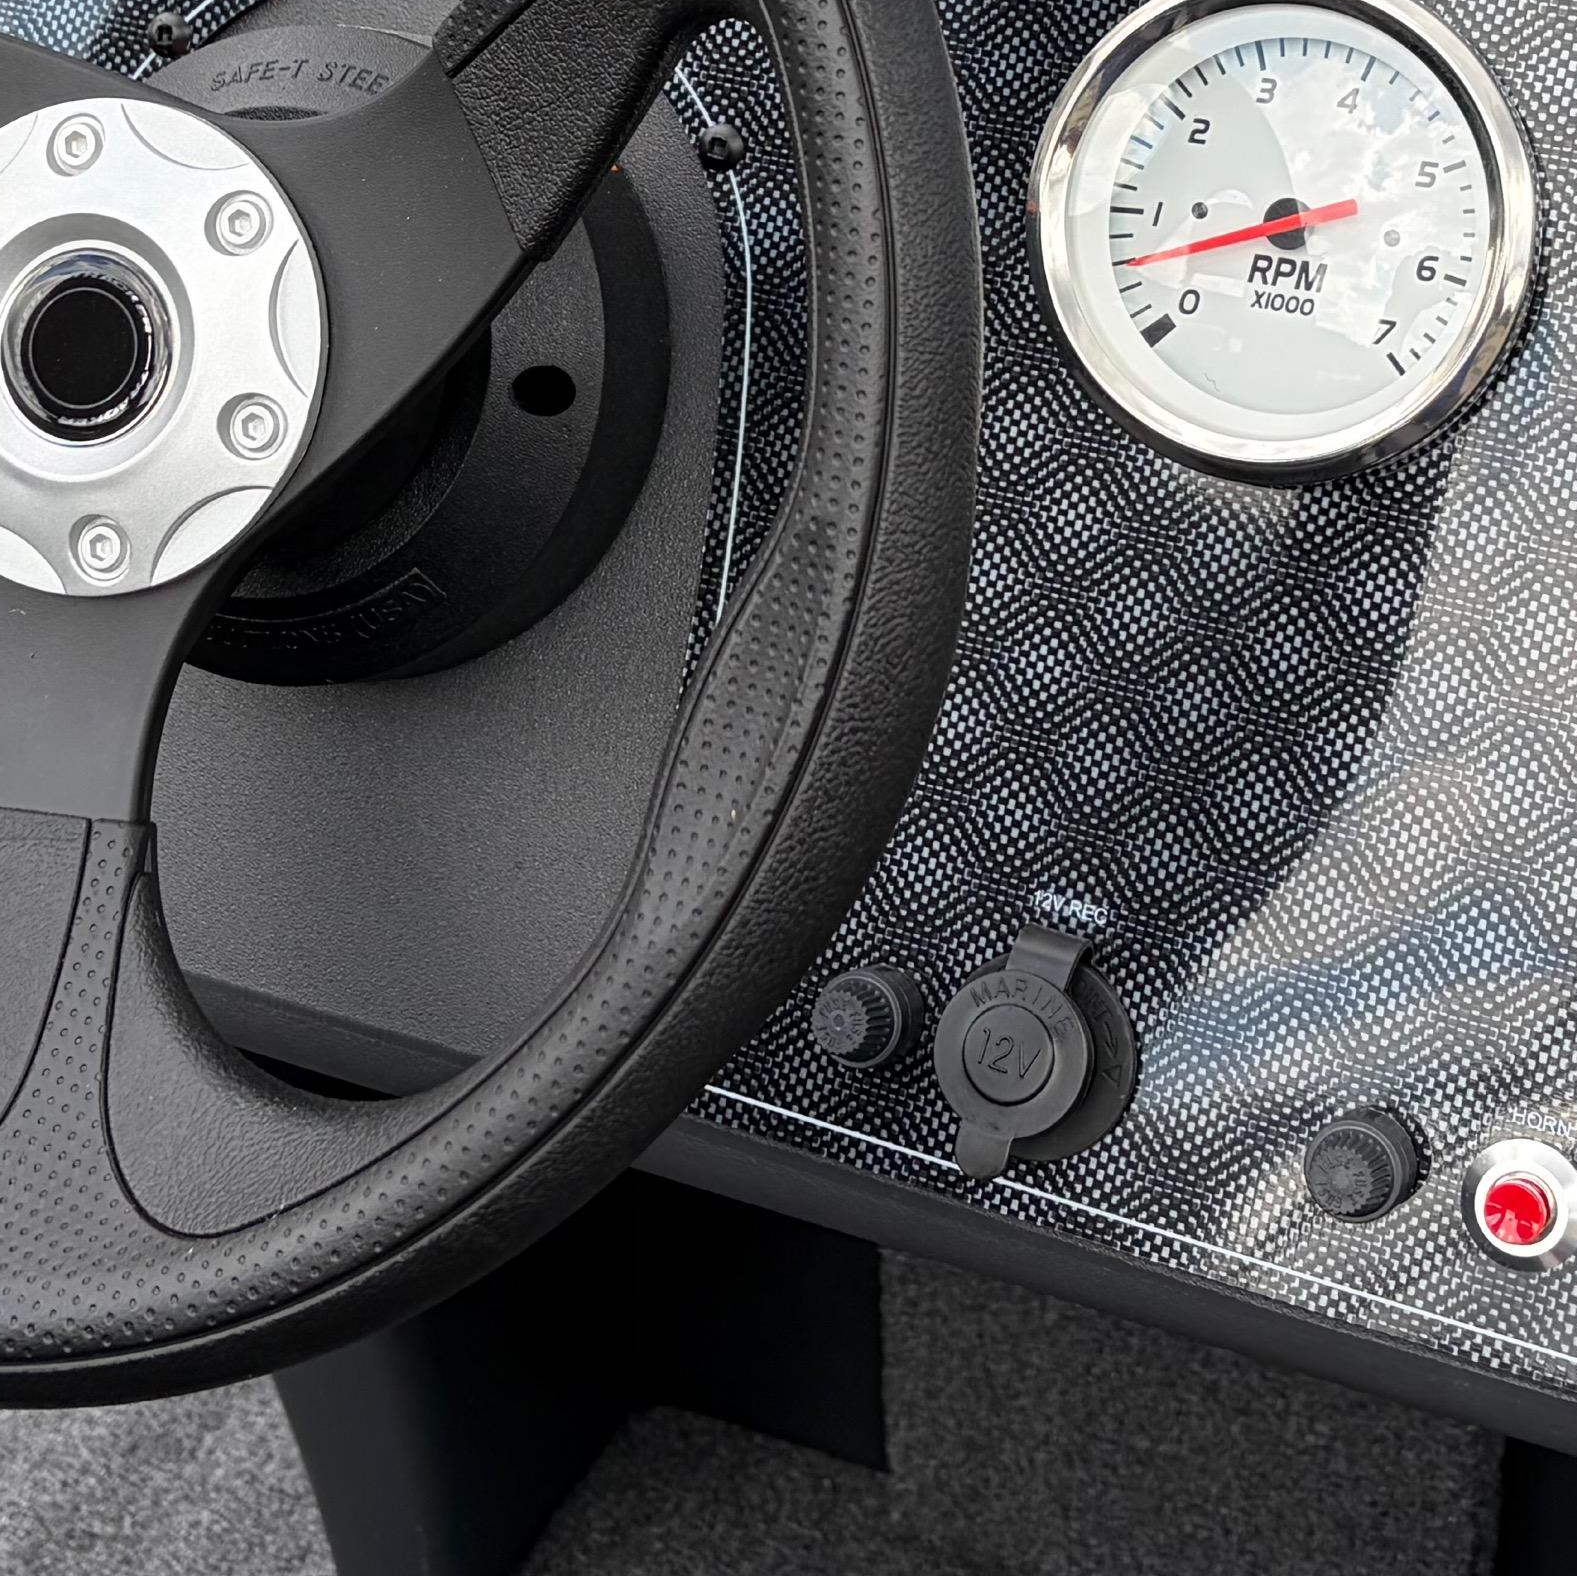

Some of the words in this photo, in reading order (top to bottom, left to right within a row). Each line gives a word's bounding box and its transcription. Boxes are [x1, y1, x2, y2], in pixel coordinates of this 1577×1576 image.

[210, 59, 309, 93] SAFE-T
[316, 61, 390, 96] STEE
[1256, 77, 1277, 104] 3
[1336, 87, 1359, 115] 4
[1187, 118, 1211, 146] 2
[1415, 160, 1440, 188] 5
[1152, 201, 1162, 227] 1
[1247, 253, 1327, 294] RPM
[1415, 255, 1437, 282] 6
[1178, 288, 1201, 315] 0
[1374, 319, 1396, 345] 7
[1033, 889, 1064, 913] 12V
[1068, 898, 1109, 926] REC
[969, 979, 1074, 1038] MARINE
[978, 1027, 1042, 1080] 12V
[1512, 1108, 1576, 1136] HORN
